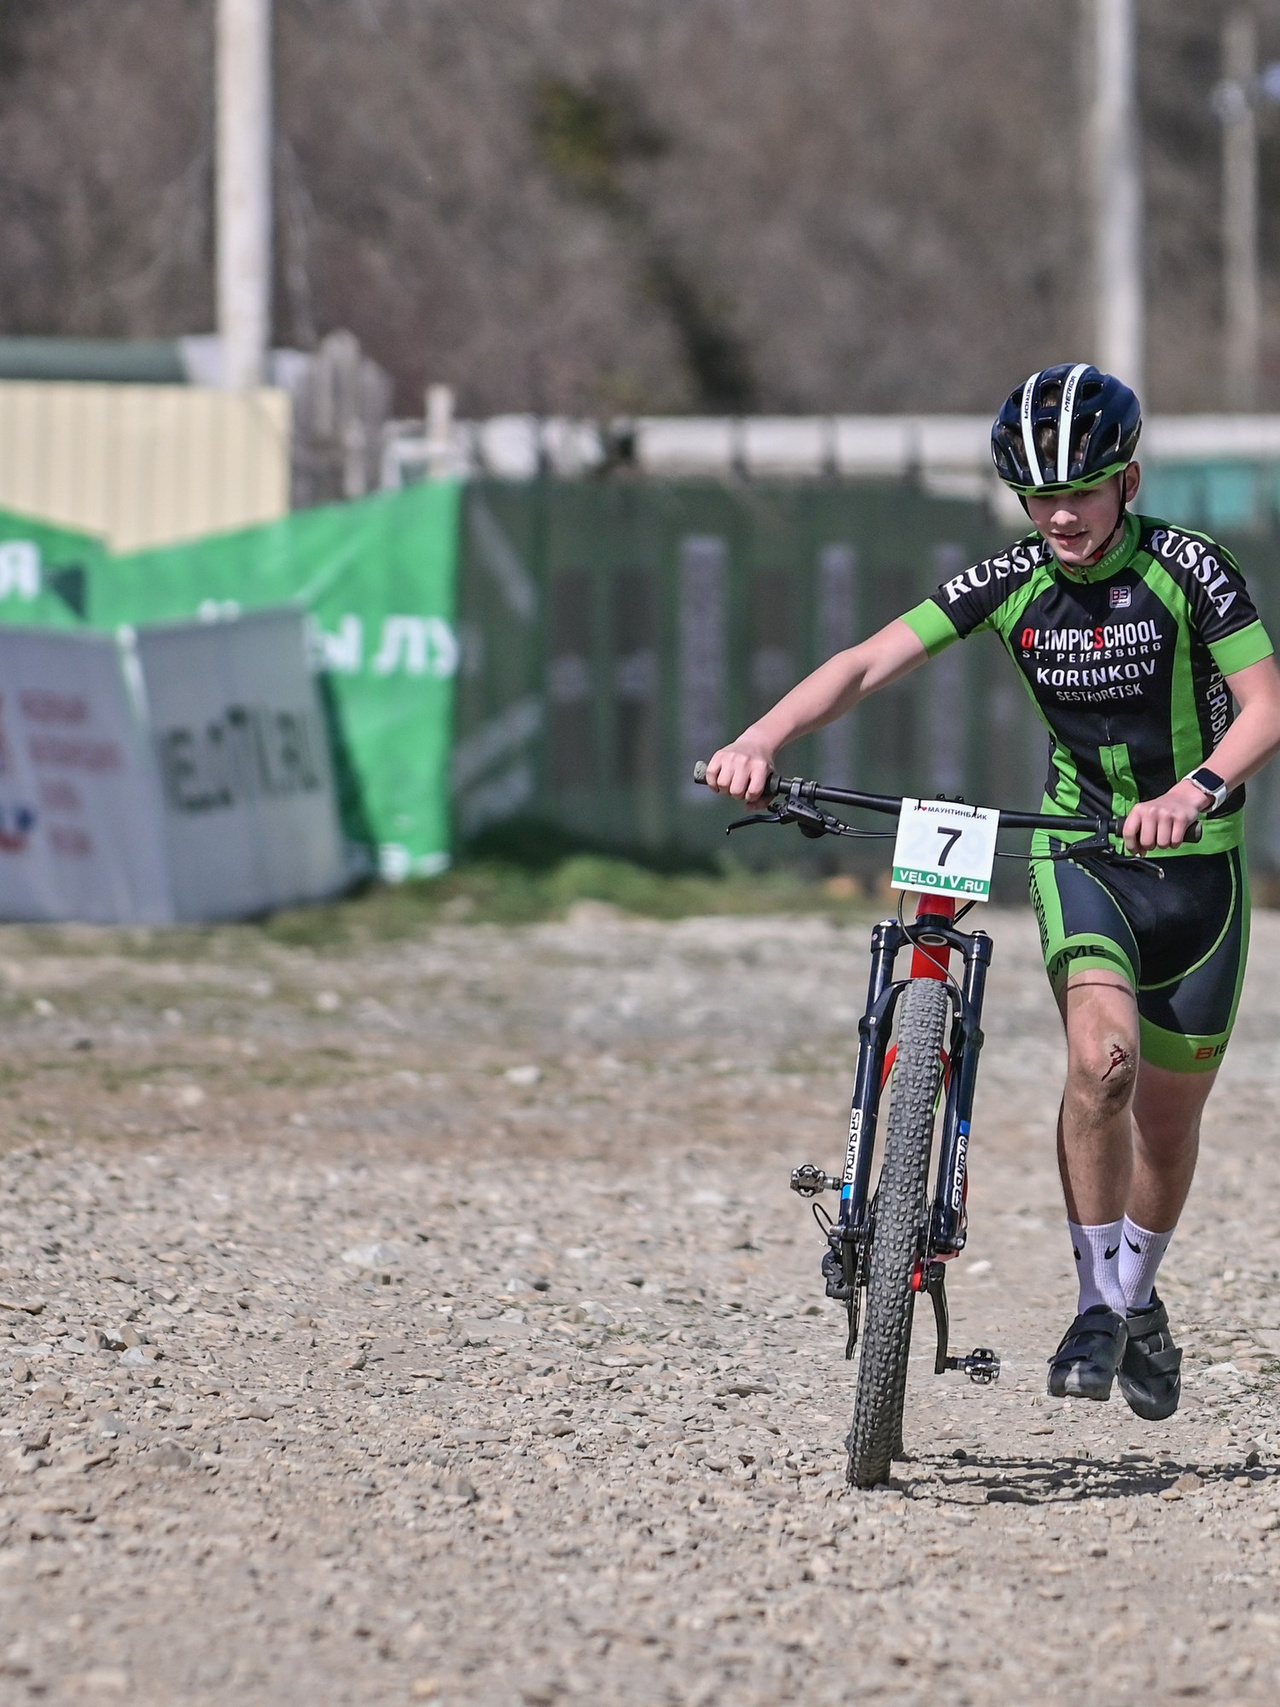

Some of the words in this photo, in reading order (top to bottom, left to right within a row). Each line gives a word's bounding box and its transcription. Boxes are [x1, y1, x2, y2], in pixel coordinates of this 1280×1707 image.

[943, 540, 1054, 604] RUSSIA
[1150, 529, 1237, 618] RUSSIA
[1022, 650, 1049, 662] ST.
[1056, 642, 1162, 663] PETERSBURG
[1036, 659, 1156, 687] KORENKOV
[937, 826, 962, 867] 7
[899, 869, 984, 893] VELOTV.RU
